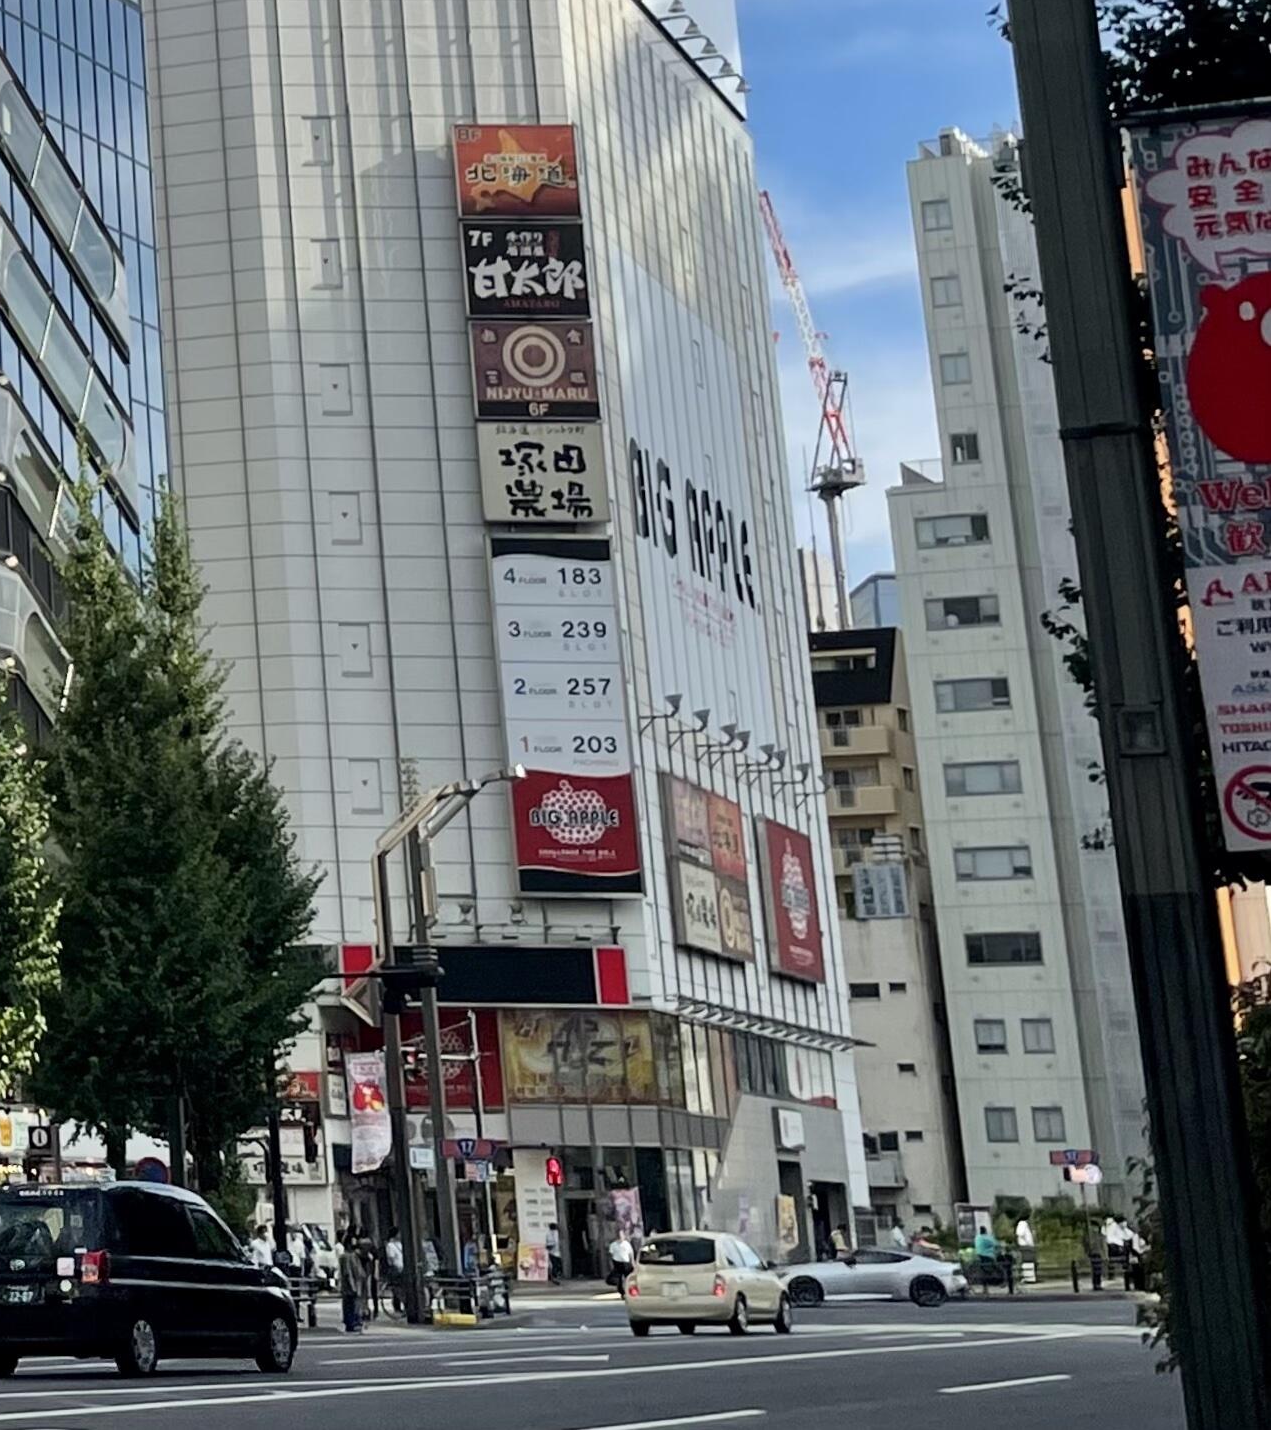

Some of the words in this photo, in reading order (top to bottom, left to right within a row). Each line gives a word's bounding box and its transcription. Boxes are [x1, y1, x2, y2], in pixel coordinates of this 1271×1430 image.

[457, 128, 481, 142] 8F
[465, 158, 570, 187] 北海道
[468, 230, 493, 247] 7F
[469, 256, 585, 299] 甘太郎
[528, 402, 550, 417] 6F
[499, 442, 586, 476] 塚田
[506, 480, 593, 518] 農場
[629, 437, 678, 559] BIG
[503, 568, 516, 584] 4
[558, 568, 601, 585] 183
[508, 621, 520, 637] 3
[562, 621, 606, 638] 239
[514, 679, 526, 695] 2
[567, 678, 611, 695] 257
[521, 736, 529, 753] 1
[573, 736, 617, 753] 203
[530, 809, 562, 827] BIG
[568, 809, 619, 827] APPLE
